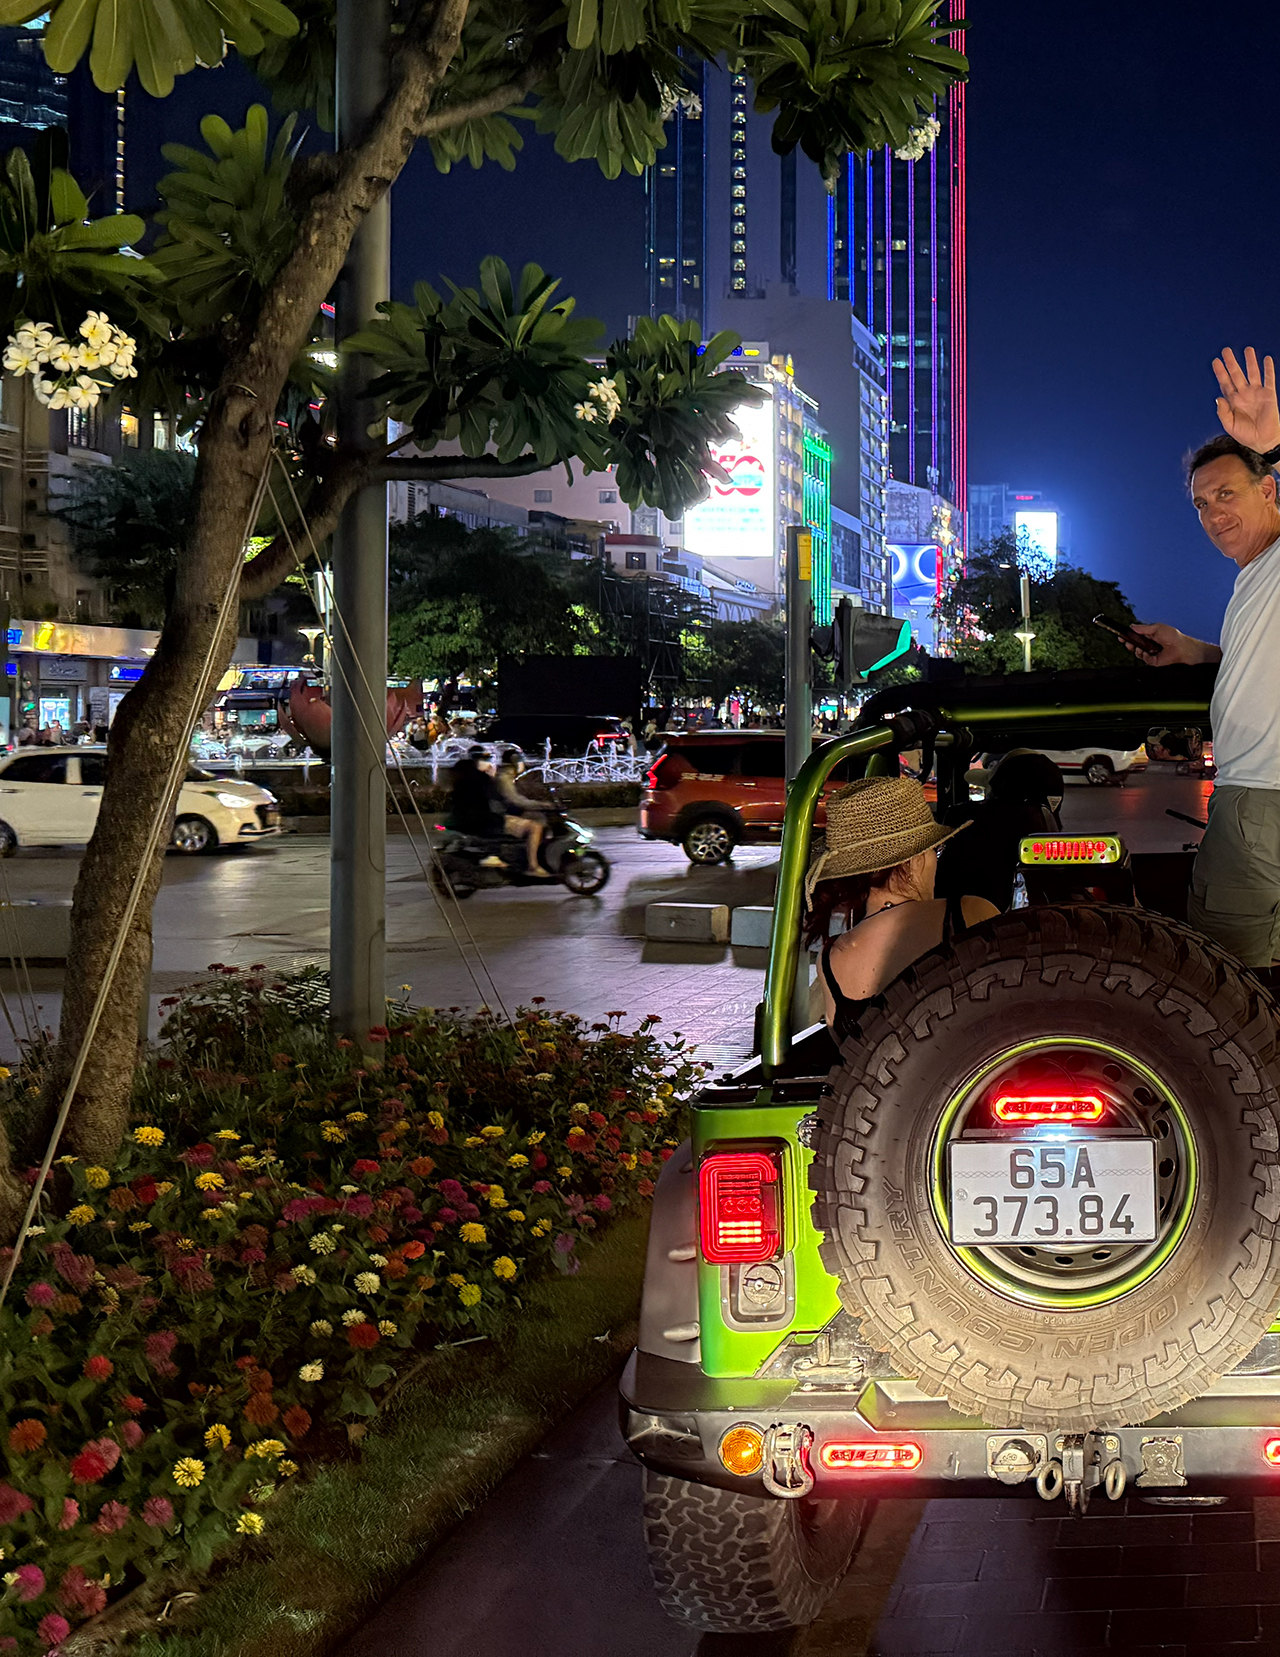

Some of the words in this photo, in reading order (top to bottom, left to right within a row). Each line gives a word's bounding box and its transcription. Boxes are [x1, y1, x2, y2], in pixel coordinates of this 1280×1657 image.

[1009, 1144, 1096, 1190] 65A
[973, 1193, 1135, 1238] 373.84
[883, 1175, 1037, 1354] COUNTRY
[1051, 1295, 1178, 1359] OPEN
